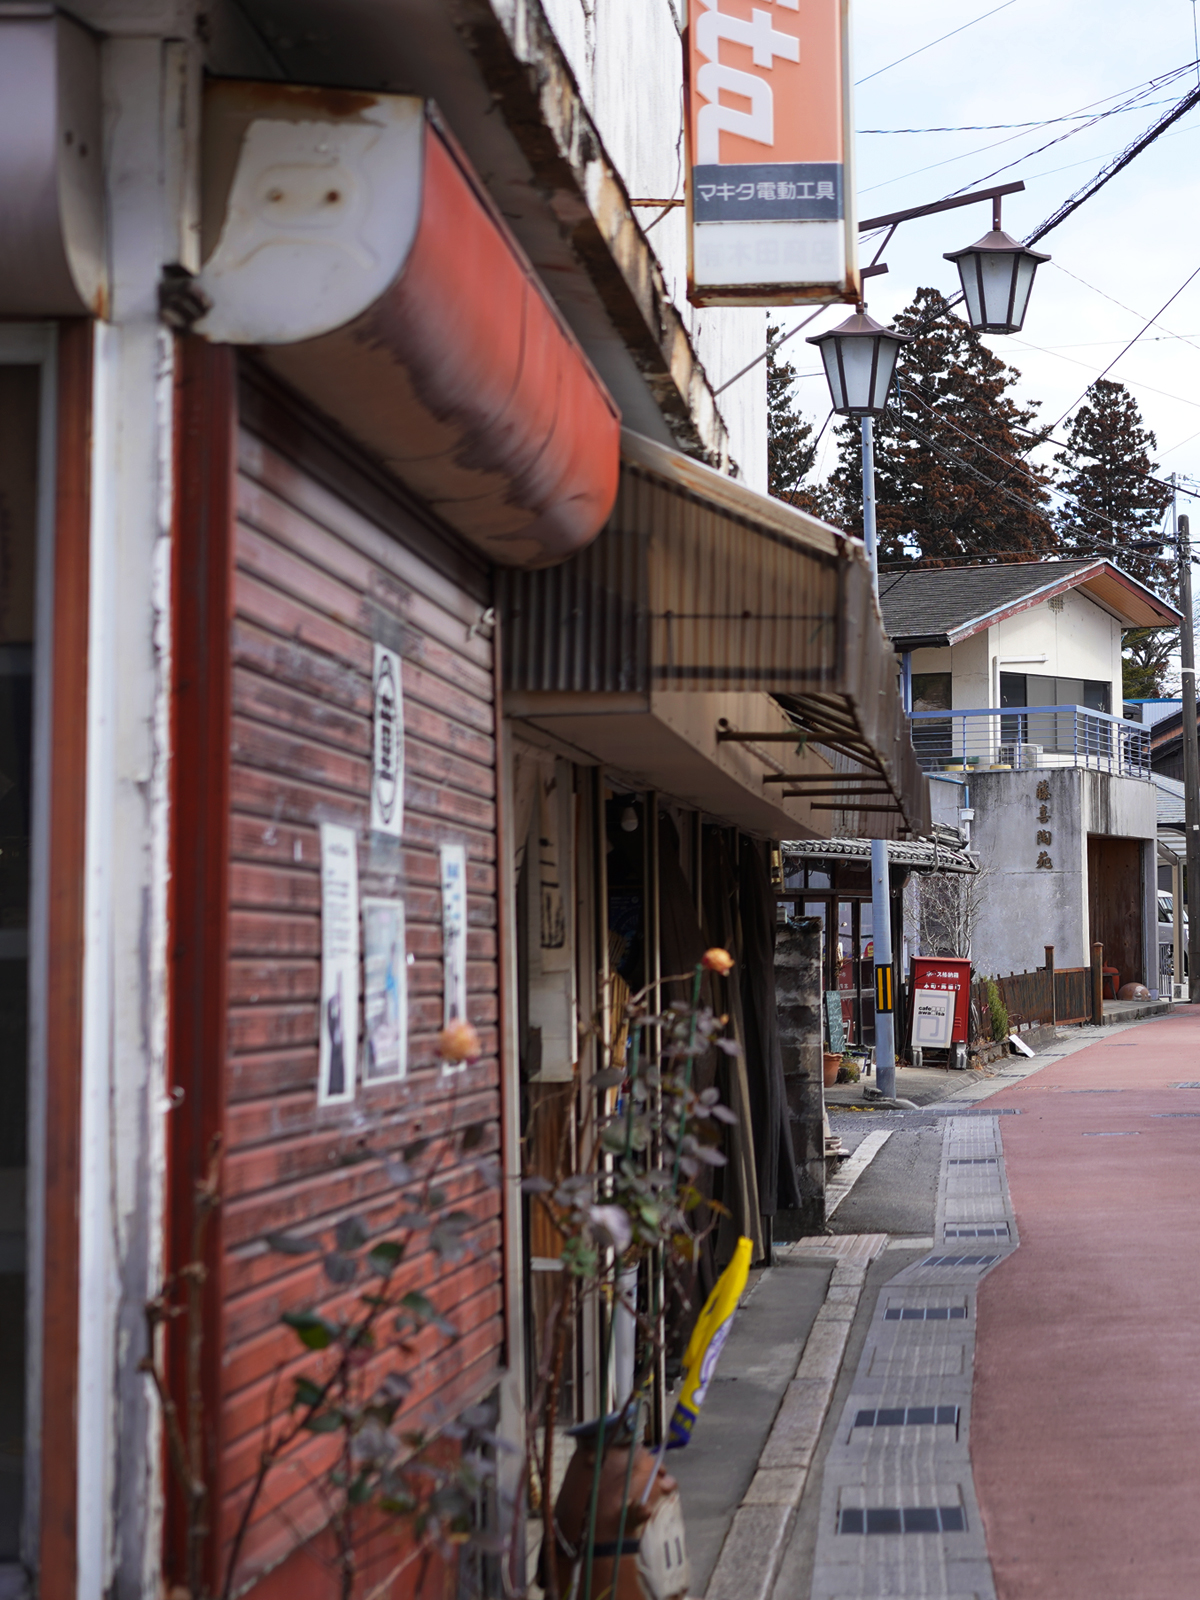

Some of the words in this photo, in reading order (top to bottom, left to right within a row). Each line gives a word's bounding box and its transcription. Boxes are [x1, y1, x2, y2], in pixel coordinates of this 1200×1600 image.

[696, 0, 799, 165] ta
[697, 181, 835, 201] マキタ電動工具
